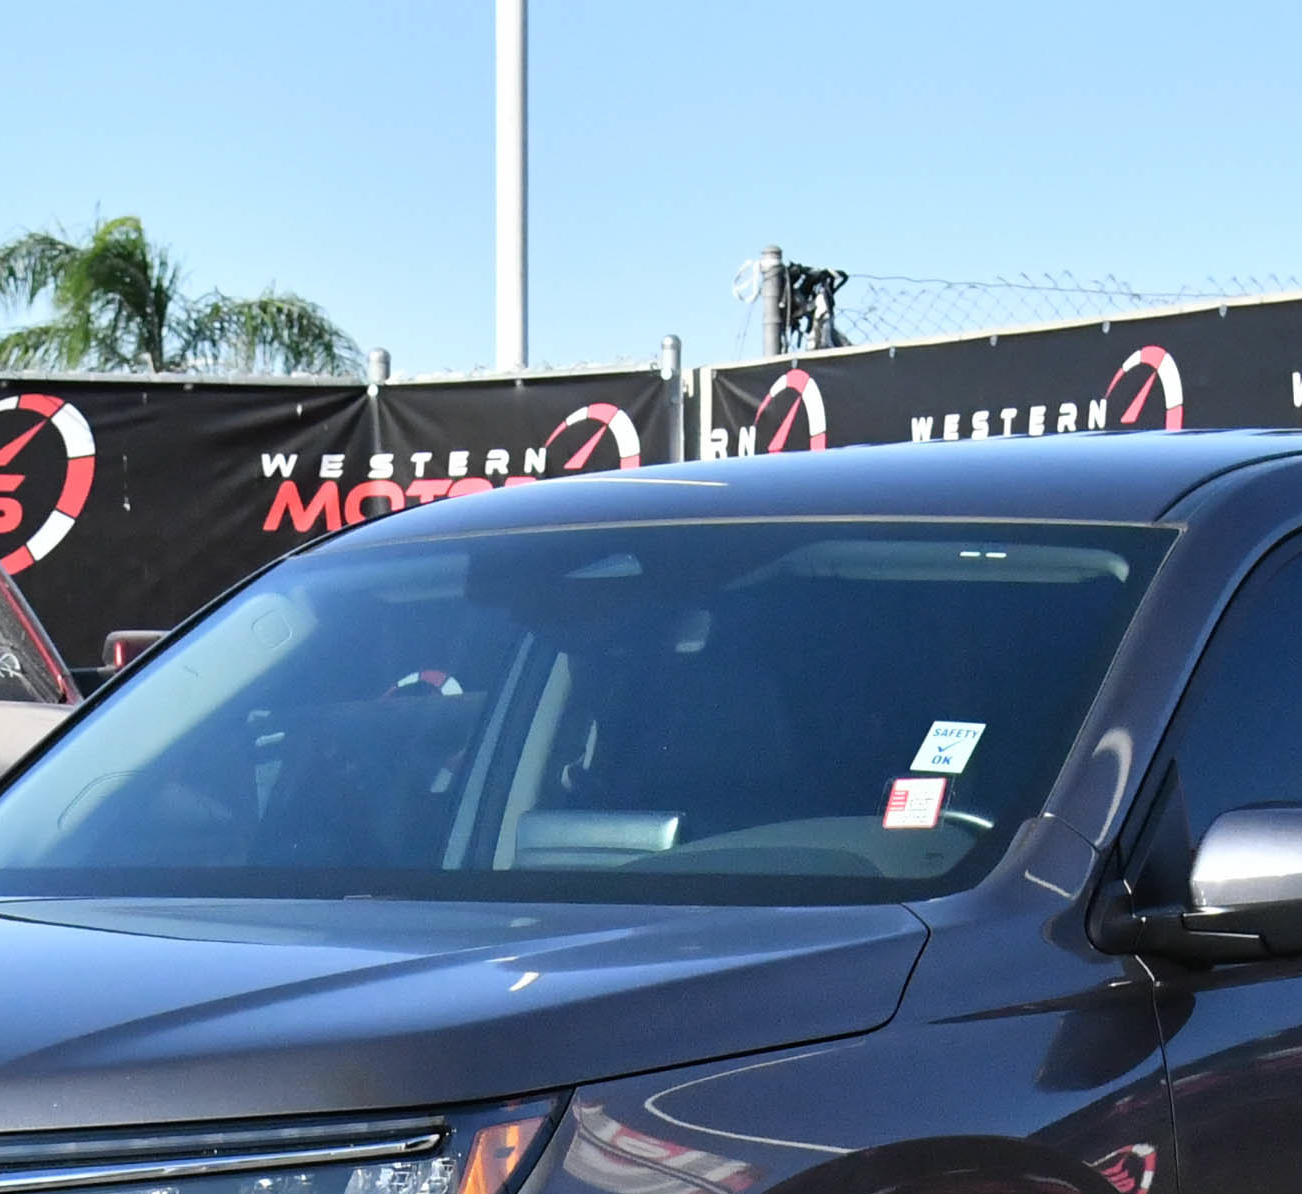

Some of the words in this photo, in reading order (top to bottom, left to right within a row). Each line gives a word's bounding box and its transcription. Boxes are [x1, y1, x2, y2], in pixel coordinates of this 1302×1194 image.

[911, 399, 1107, 442] WESTERN
[261, 447, 546, 479] WESTERN
[933, 727, 979, 739] SAFETY
[931, 754, 953, 765] OK
